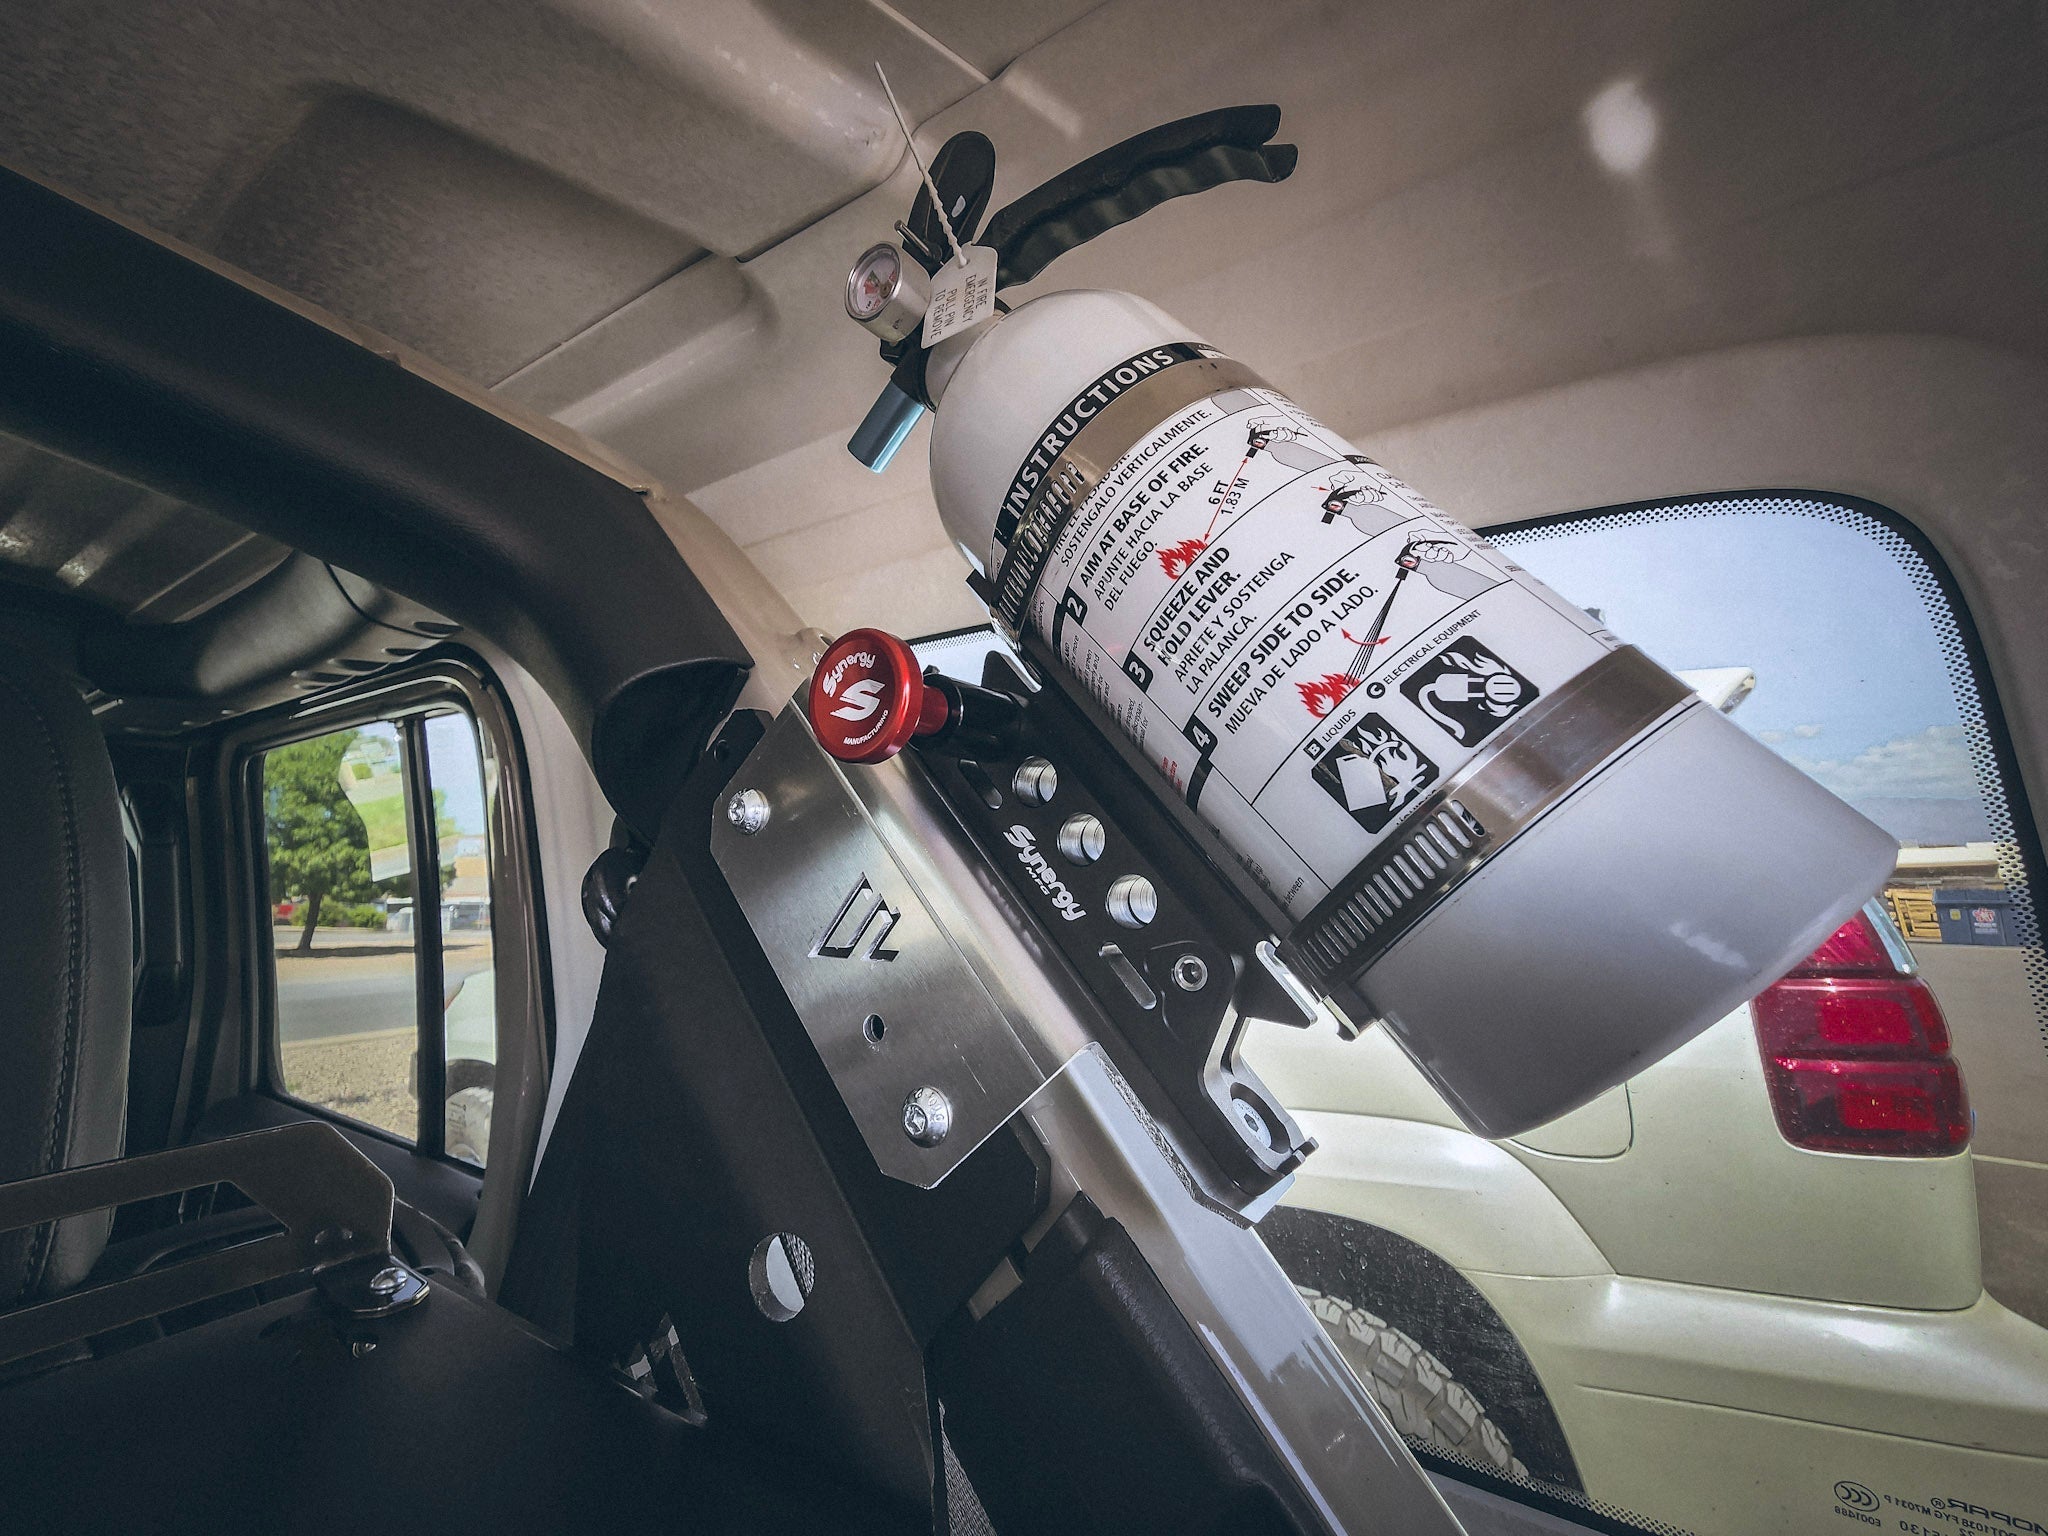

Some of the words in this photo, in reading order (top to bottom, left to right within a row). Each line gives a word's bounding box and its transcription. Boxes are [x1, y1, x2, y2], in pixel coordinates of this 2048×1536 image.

[935, 288, 946, 302] TO
[945, 288, 958, 312] PULL
[963, 274, 977, 323] EMERGENCY
[976, 289, 988, 309] FIRE
[979, 277, 987, 287] IN
[931, 303, 945, 339] REMOVE
[944, 311, 956, 328] PIN
[1004, 350, 1174, 520] INSTRUCTIONS
[1060, 486, 1117, 568] SOSTENGALO
[1112, 409, 1213, 487] VERTICALMENTE.
[1208, 496, 1222, 506] 6
[1213, 479, 1229, 497] FT
[1220, 490, 1242, 517] 1.83
[1237, 477, 1250, 490] M
[1067, 596, 1084, 617] 2
[1079, 551, 1102, 588] AIM
[1098, 530, 1118, 557] AT
[1112, 490, 1151, 534] BASE
[1147, 469, 1170, 494] OF
[1167, 443, 1210, 475] FIRE.
[1093, 547, 1129, 602] APUNTE
[1125, 511, 1164, 549] HACIA
[1159, 491, 1181, 510] LA
[1176, 462, 1214, 493] BASE
[1104, 588, 1124, 612] DEL
[1118, 540, 1159, 587] FUEGO.
[1128, 661, 1146, 684] 3
[1143, 580, 1199, 653] SQUEEZE
[1194, 546, 1230, 586] AND
[1156, 620, 1203, 668] HOLD
[1187, 570, 1242, 624] LEVER.
[1173, 626, 1218, 684] APRIETE
[1210, 614, 1226, 630] Y
[1222, 550, 1296, 619] SOSTENGA
[1093, 653, 1101, 672] and
[1185, 674, 1205, 696] LA
[1198, 613, 1259, 678] PALANCA.
[1191, 725, 1211, 749] 4
[1207, 661, 1252, 719] SWEEP
[1249, 622, 1293, 666] SIDE
[1284, 602, 1314, 628] TO
[1310, 567, 1361, 606] SIDE.
[1224, 686, 1269, 736] MUEVA
[1261, 664, 1287, 689] DE
[1280, 628, 1322, 669] LADO
[1320, 617, 1337, 634] A
[1331, 584, 1380, 621] LADO.
[1383, 643, 1436, 686] ELECTRICAL
[1433, 609, 1482, 645] EQUIPMENT
[822, 651, 876, 698] Synergy
[843, 709, 889, 745] MANUFACTURING
[1321, 709, 1358, 744] LIQUIDS
[1002, 824, 1087, 921] Synergy
[1025, 866, 1050, 896] MFG
[1283, 876, 1305, 906] between
